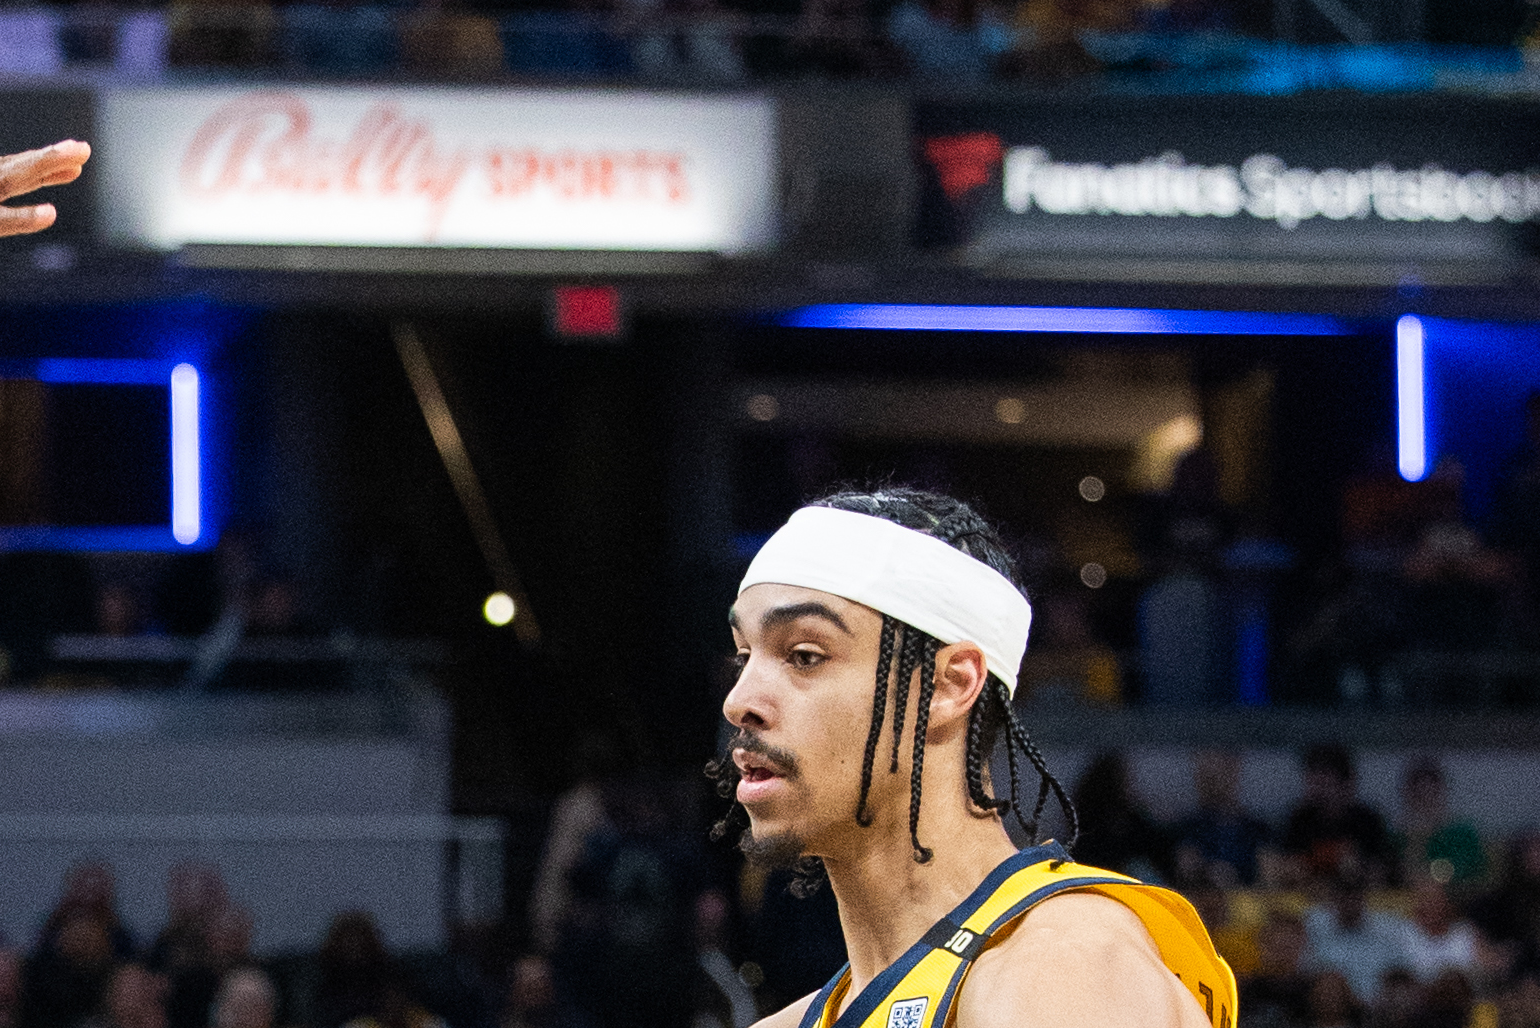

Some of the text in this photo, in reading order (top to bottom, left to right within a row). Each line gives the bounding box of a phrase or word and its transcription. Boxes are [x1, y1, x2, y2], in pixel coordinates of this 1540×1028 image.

[178, 88, 691, 242] Bally SPORTS
[1003, 145, 1244, 217] Fanatics
